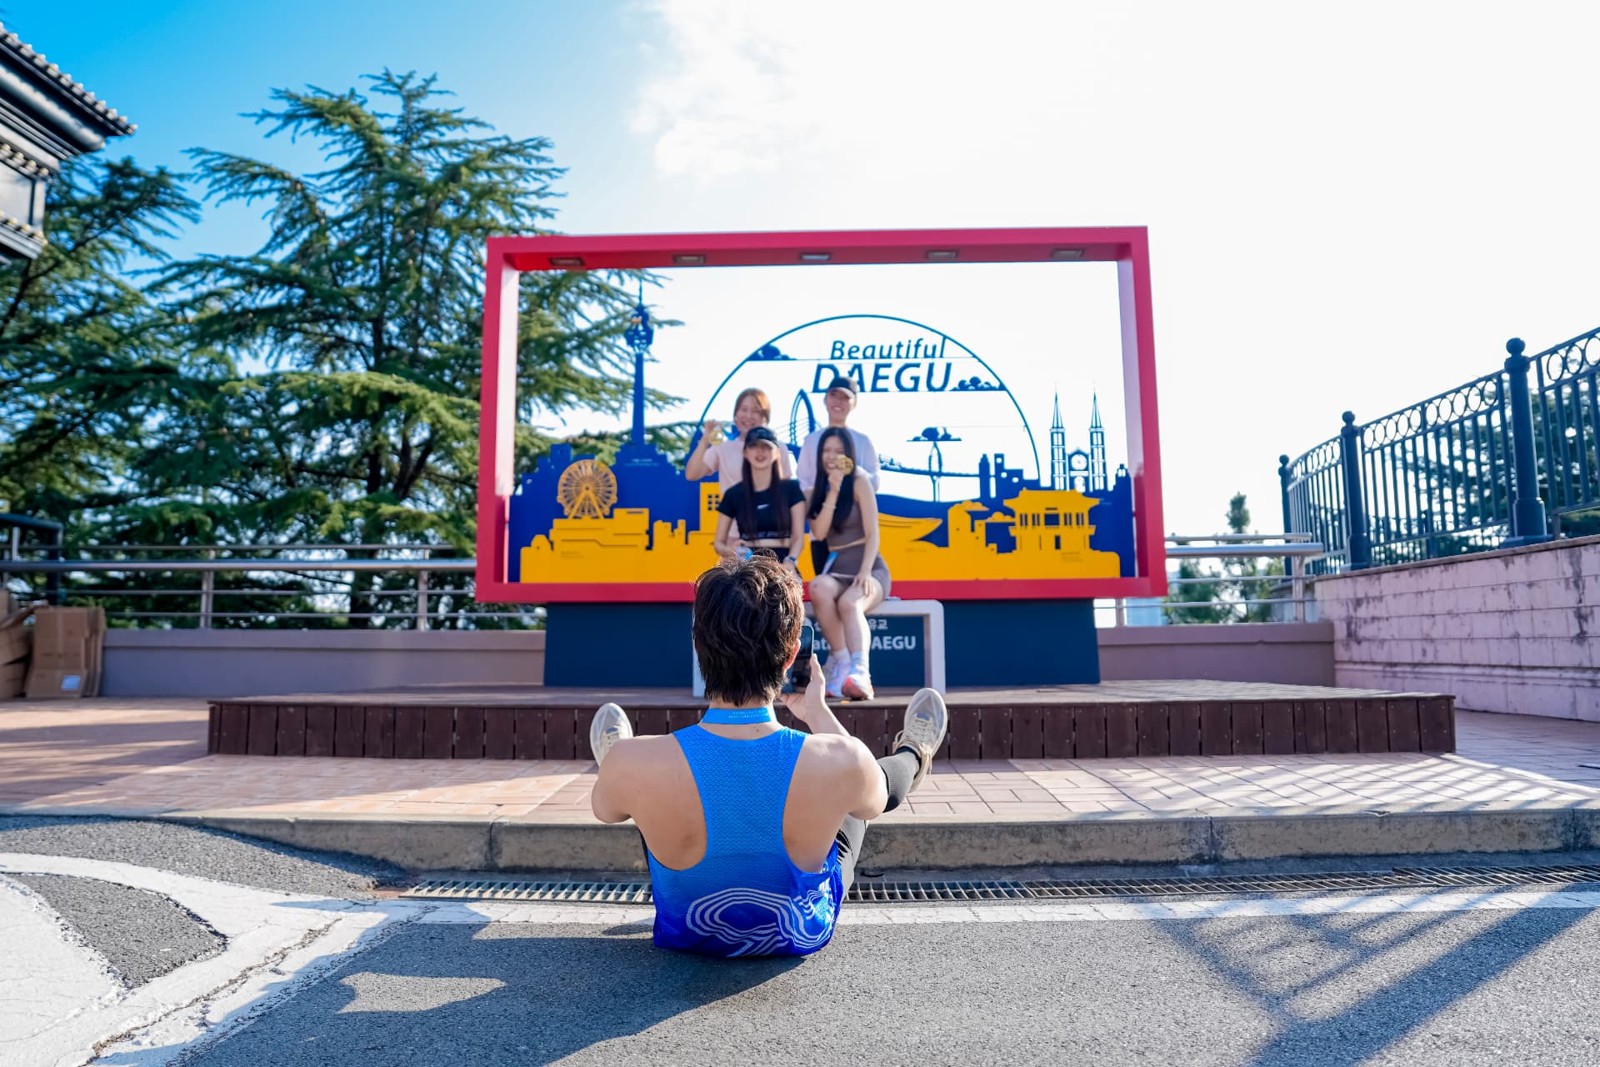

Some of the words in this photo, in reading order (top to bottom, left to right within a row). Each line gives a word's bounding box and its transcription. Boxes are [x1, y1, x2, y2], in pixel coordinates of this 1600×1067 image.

[828, 335, 946, 360] Beautiful
[811, 361, 951, 393] DAEGU
[871, 635, 916, 651] AEGU
